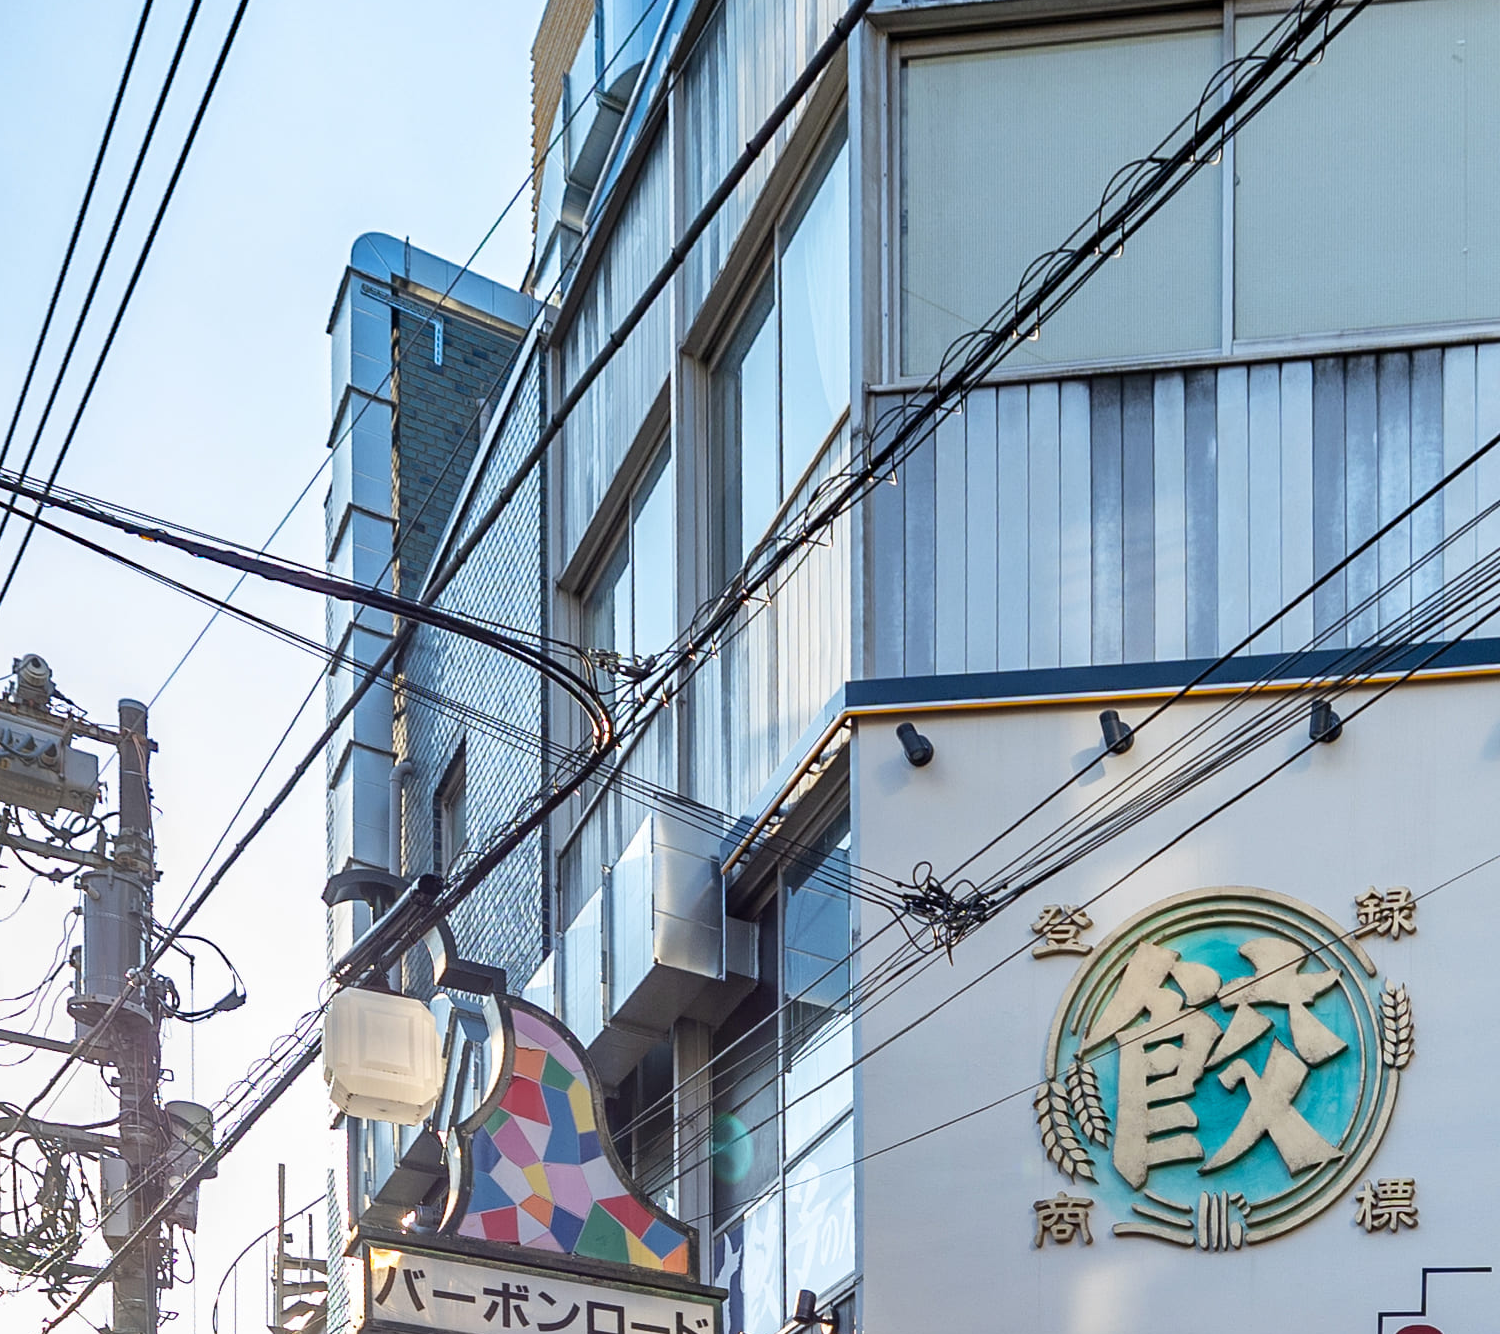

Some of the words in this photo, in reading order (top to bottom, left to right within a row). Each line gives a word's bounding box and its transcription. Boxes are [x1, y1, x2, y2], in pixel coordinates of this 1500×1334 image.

[1084, 937, 1345, 1190] 餃
[1032, 1191, 1096, 1247] 商
[1354, 1177, 1419, 1233] 標
